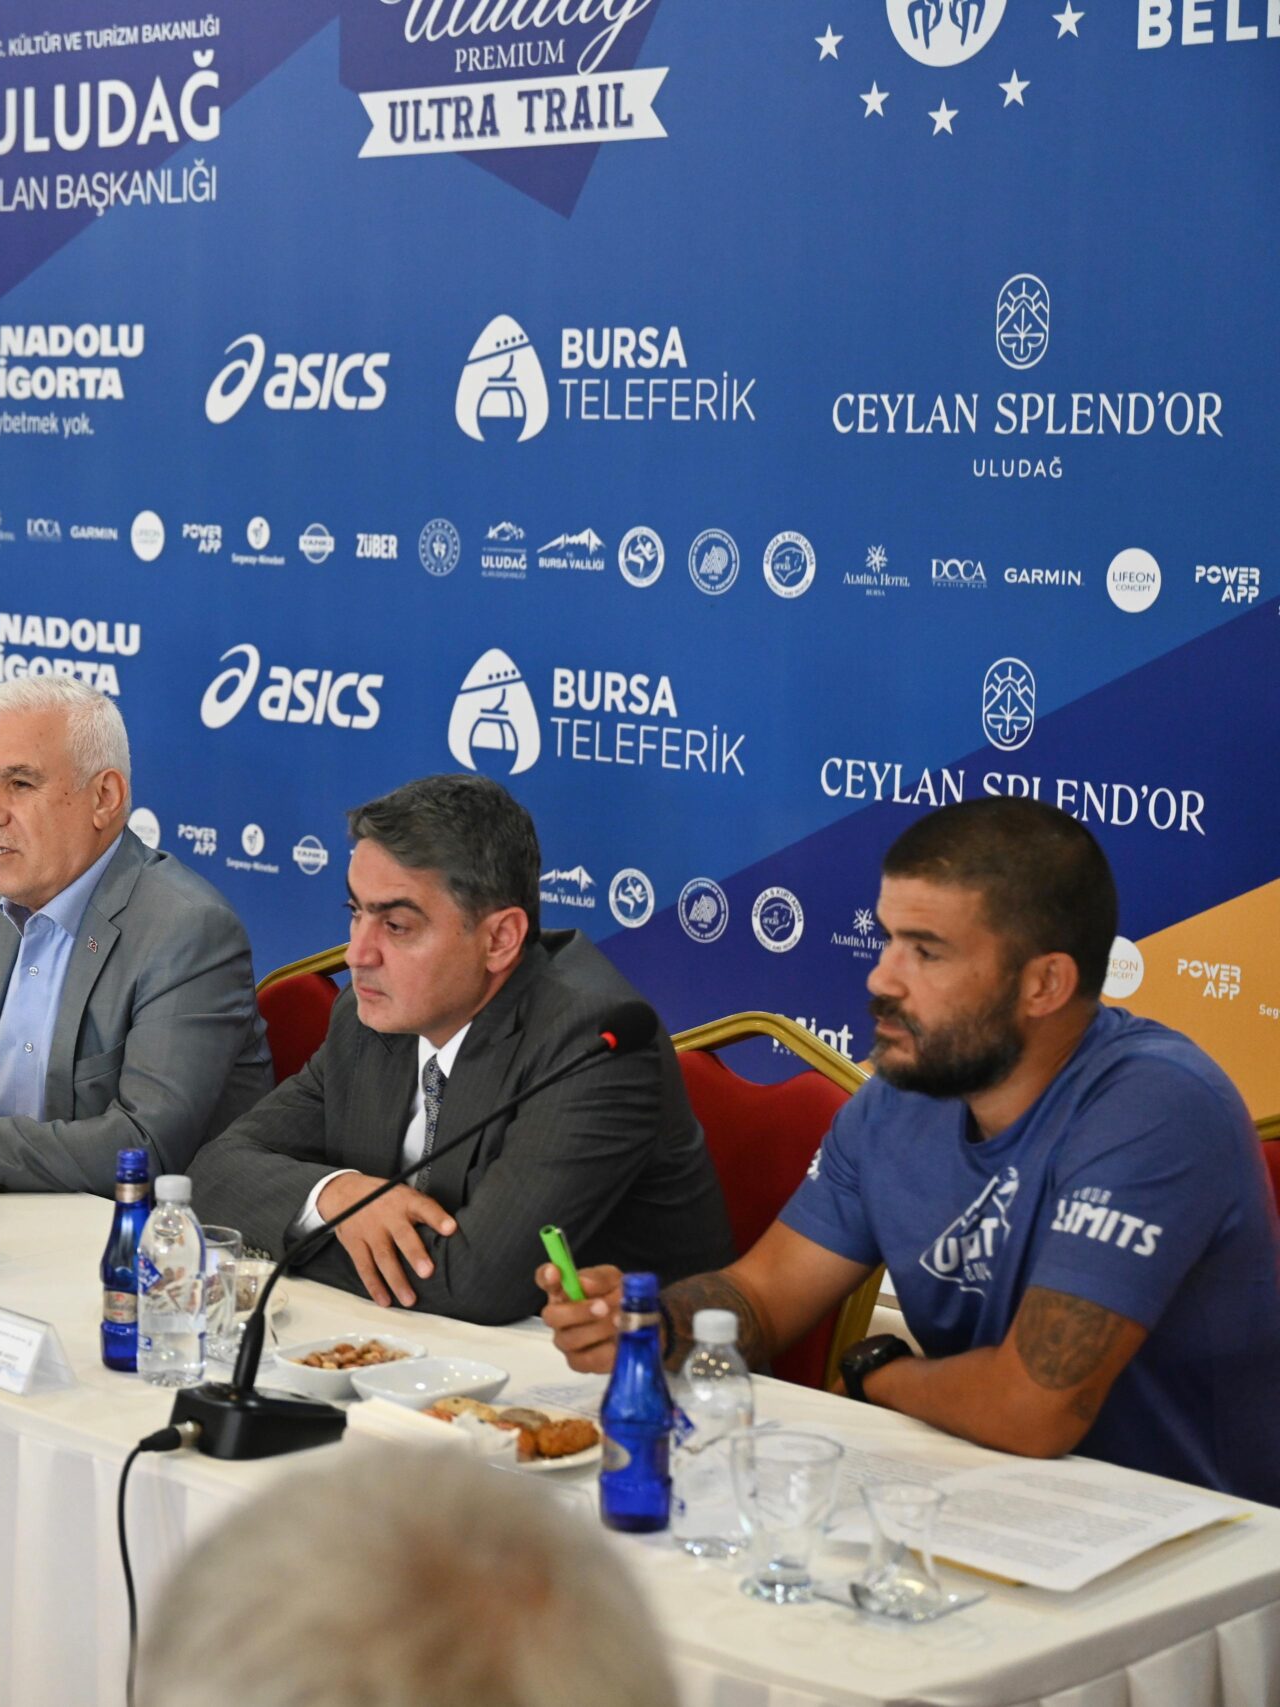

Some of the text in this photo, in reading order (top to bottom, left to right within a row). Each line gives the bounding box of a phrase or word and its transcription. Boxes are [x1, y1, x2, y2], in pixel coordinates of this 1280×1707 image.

[8, 33, 61, 56] KÜLTÜR
[64, 33, 81, 51] VE
[85, 24, 138, 49] TURİZM
[142, 14, 220, 44] BAKANLIĞI
[454, 39, 565, 73] PREMIUM
[388, 82, 634, 143] ULTRA TRAIL
[56, 158, 216, 217] BAŞKANLIĞI
[561, 326, 688, 369] BURSA
[559, 370, 756, 421] TELEFERİK
[832, 392, 1223, 437] CEYLAN SPLEND'OR
[62, 412, 95, 439] yok.
[973, 456, 1063, 478] ULUDAĞ
[70, 525, 118, 541] GARMIN
[182, 524, 222, 539] POWER
[198, 539, 222, 554] APP
[481, 554, 527, 570] ULUDAĞ
[539, 557, 568, 569] BURSA
[881, 573, 910, 587] HOTEL
[1004, 567, 1082, 586] GARMIN
[1112, 571, 1156, 583] LIFEON
[1195, 565, 1260, 585] POWER
[1116, 583, 1151, 593] CONCEPT
[1221, 585, 1259, 604] APP
[553, 667, 678, 718] BURSA
[551, 716, 745, 776] TELEFERİK
[820, 757, 965, 807] CEYLAN
[178, 824, 217, 841] POWER
[193, 841, 217, 856] APP
[1177, 958, 1241, 983] POWER
[1203, 981, 1240, 1000] APP
[1051, 1199, 1163, 1257] LIMITS
